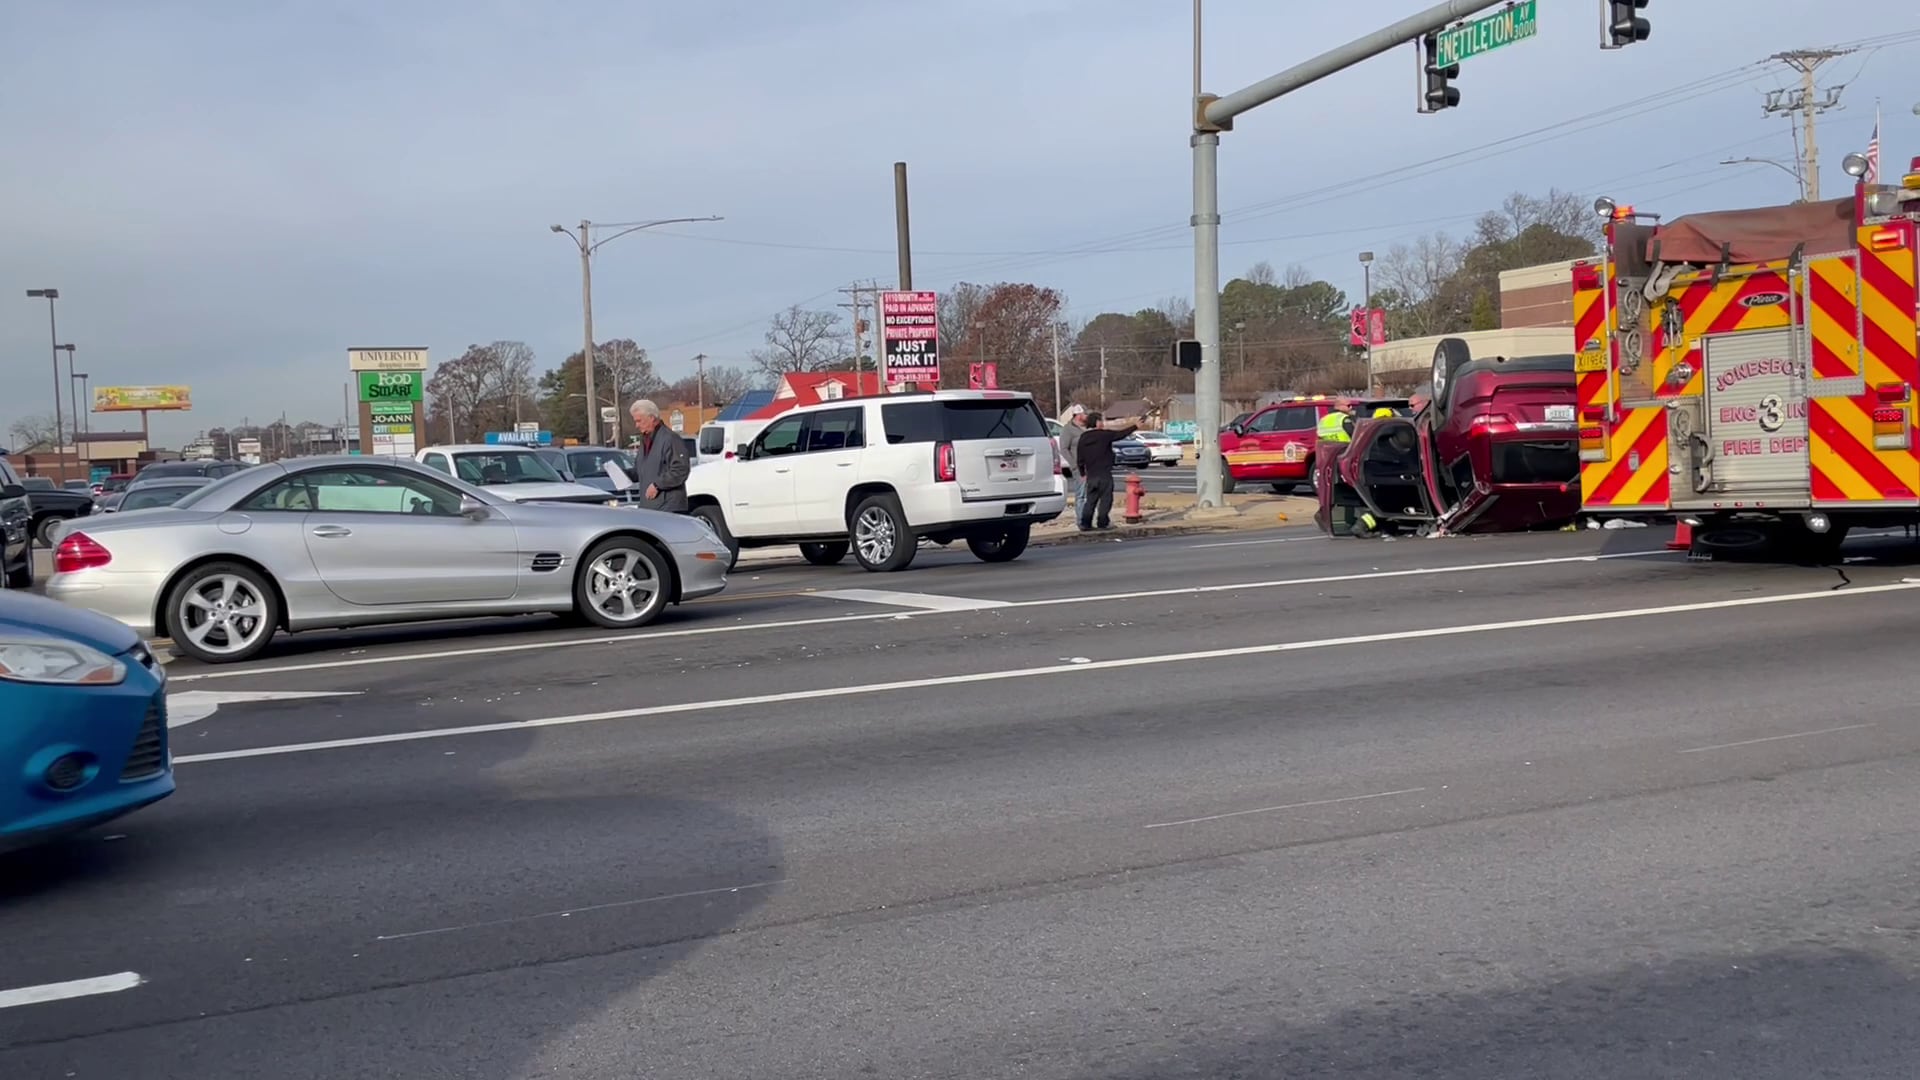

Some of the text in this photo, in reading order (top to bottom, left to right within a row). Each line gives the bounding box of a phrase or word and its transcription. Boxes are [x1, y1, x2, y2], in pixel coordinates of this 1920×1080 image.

[1444, 11, 1514, 63] NETTLETON
[1520, 3, 1530, 21] AV
[1513, 18, 1535, 40] 3000
[886, 316, 895, 324] NO
[895, 340, 927, 352] JUST
[360, 351, 420, 361] UNIVERSITY
[888, 353, 935, 366] PARK IT
[1720, 405, 1757, 423] ENG
[1759, 393, 1785, 433] 3
[498, 432, 539, 443] AVAILABLE
[1722, 436, 1808, 456] FIRE DEP
